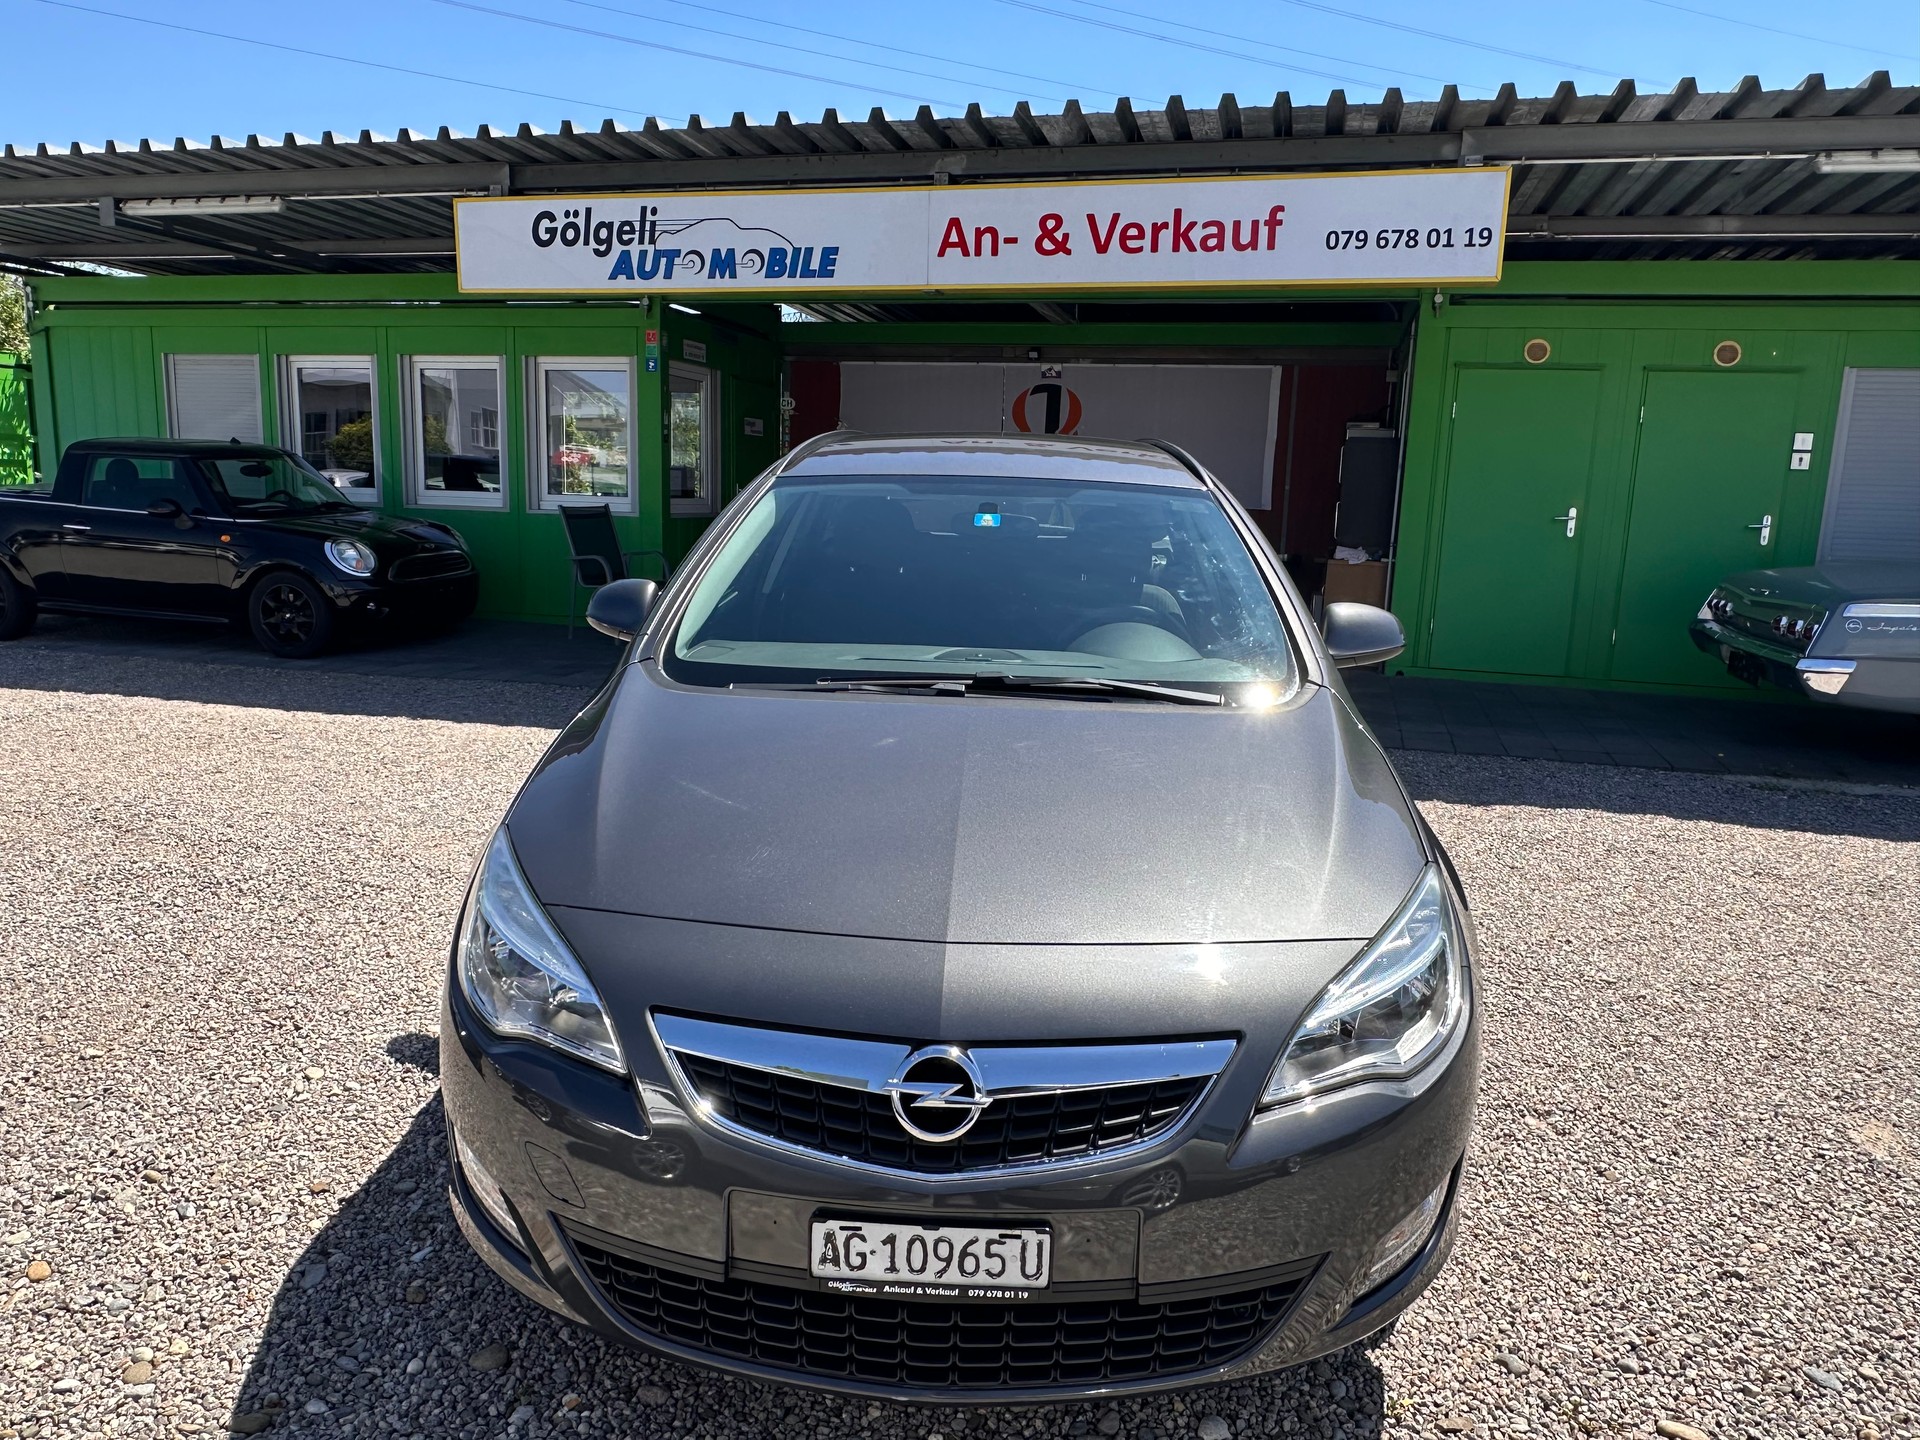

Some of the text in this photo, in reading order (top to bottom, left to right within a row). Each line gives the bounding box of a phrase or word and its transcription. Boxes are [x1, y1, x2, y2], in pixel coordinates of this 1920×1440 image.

[531, 206, 658, 257] Gölgeli
[936, 204, 1286, 258] An- & Verkauf
[1325, 226, 1493, 251] 079 678 01 19
[883, 1285, 914, 1294] Ankauf
[925, 1287, 959, 1297] Verkauf
[968, 1289, 985, 1298] 079
[986, 1290, 1003, 1299] 678
[1004, 1291, 1015, 1299] 01
[1018, 1291, 1029, 1299] 19
